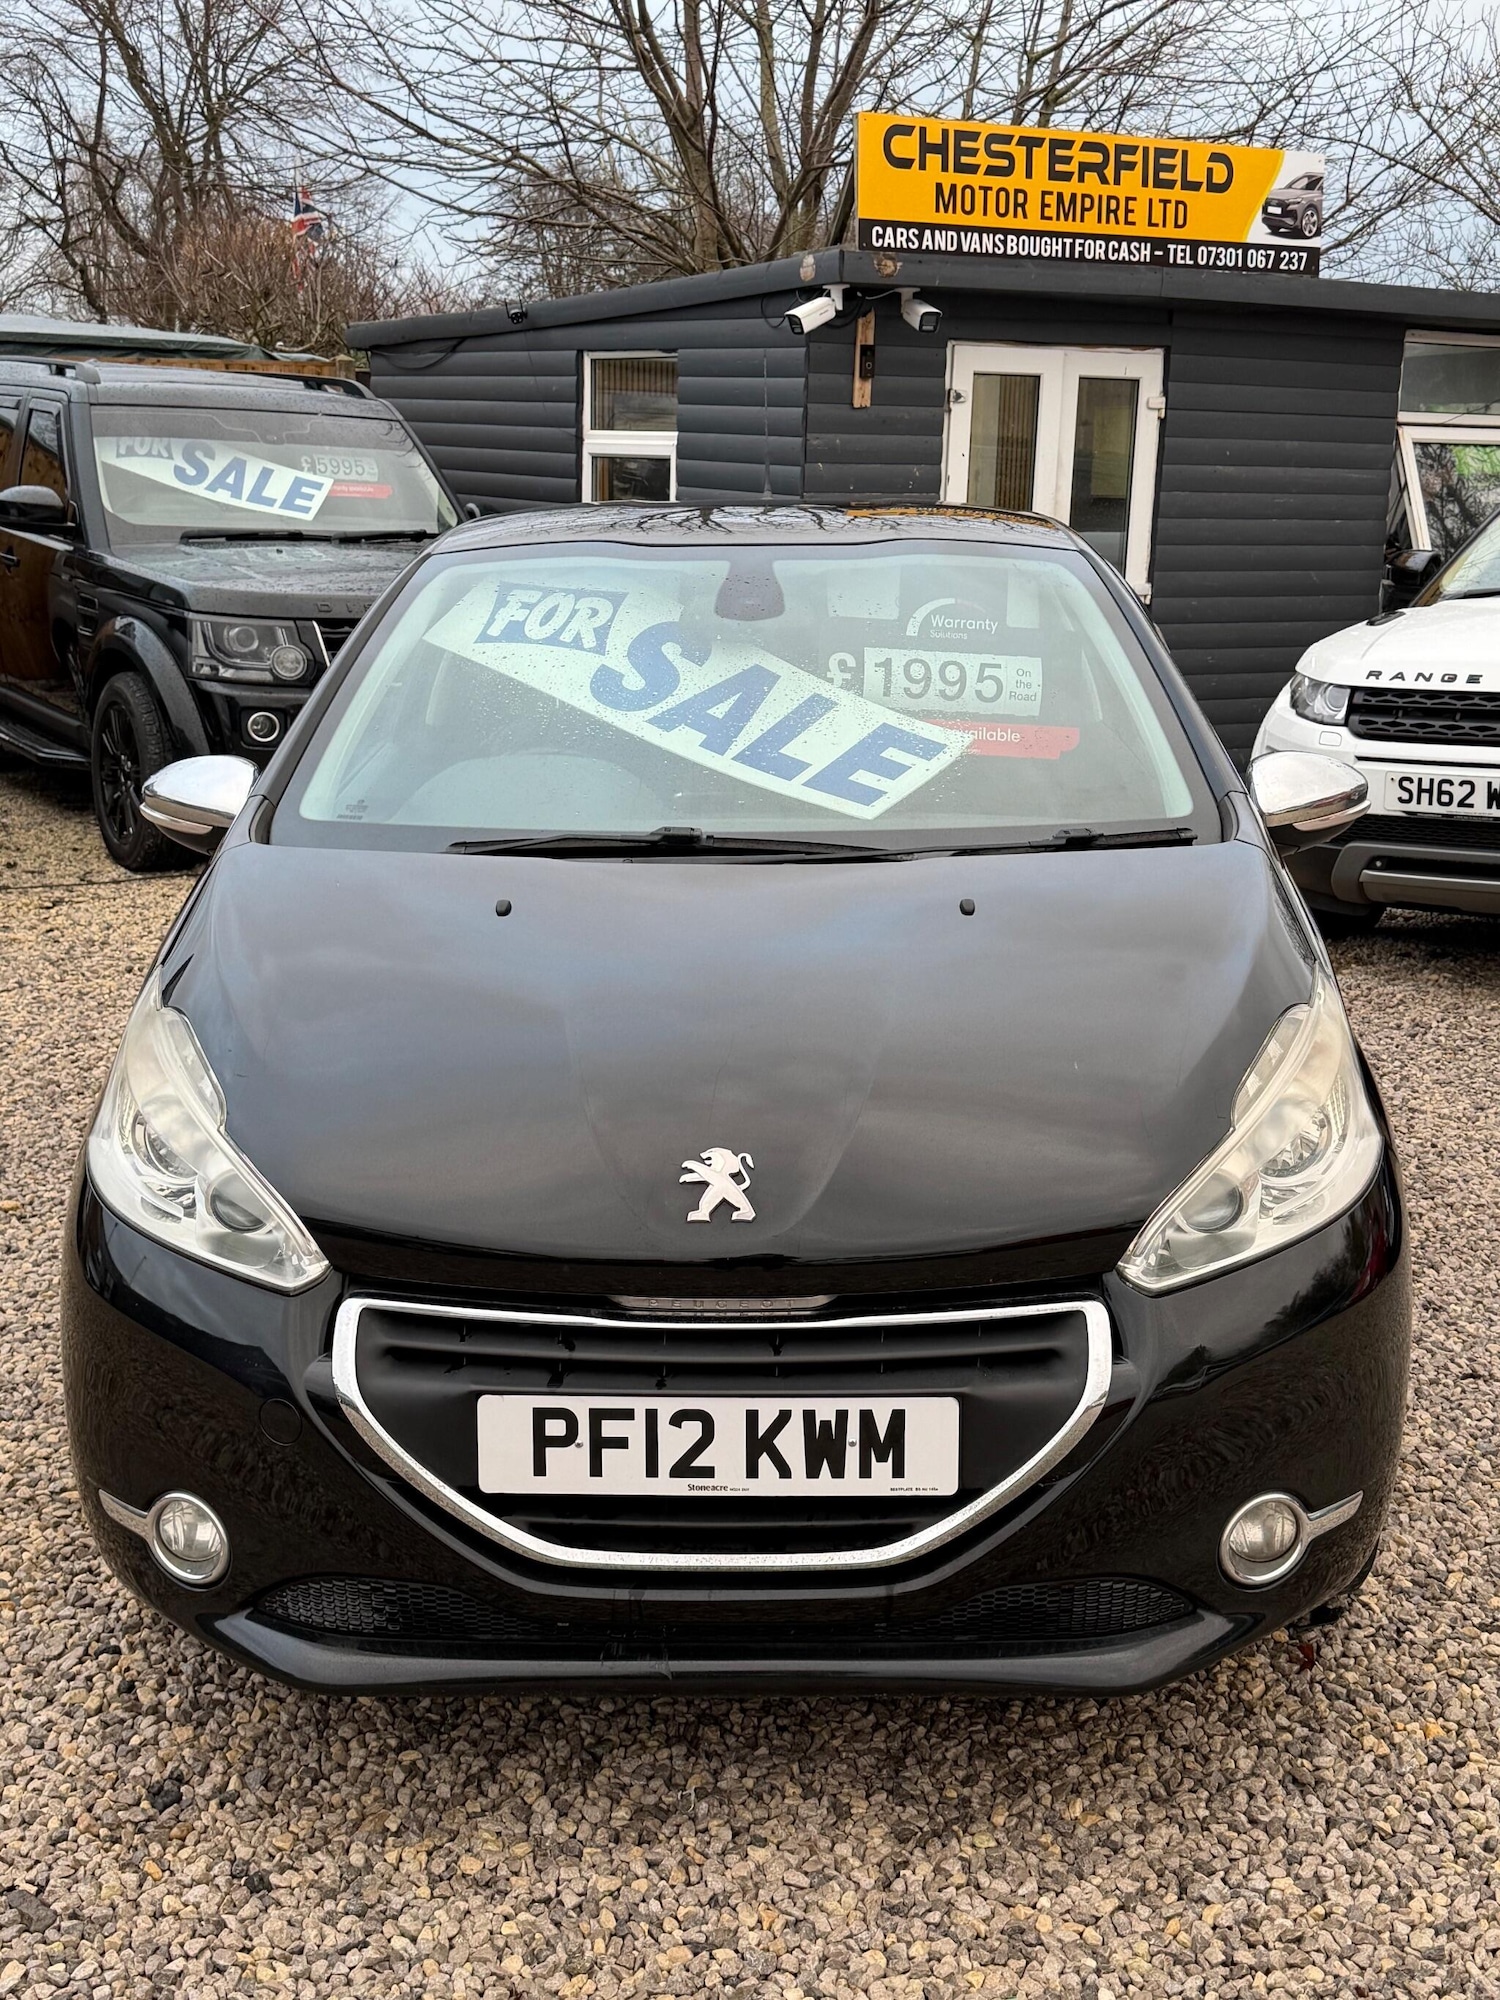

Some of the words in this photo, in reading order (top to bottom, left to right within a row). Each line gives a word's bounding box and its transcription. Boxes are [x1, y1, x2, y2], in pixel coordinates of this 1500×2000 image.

[883, 123, 1234, 194] CHESTERFIELD
[935, 182, 1028, 219] MOTOR
[1040, 190, 1137, 226] EMPIRE
[1147, 198, 1188, 229] LTD
[871, 225, 919, 250] CARS
[921, 229, 958, 252] AND
[959, 231, 1005, 255] VANS
[1009, 234, 1073, 259] BOUGHT
[1074, 239, 1106, 260] FOR
[1108, 241, 1150, 263] CASH
[1167, 244, 1194, 265] TEL
[1197, 246, 1242, 268] 07301
[1246, 248, 1275, 269] 067
[1279, 251, 1308, 271] 237
[173, 442, 325, 514] SALE
[930, 614, 998, 635] Warranty
[930, 629, 968, 640] Solutions
[1016, 668, 1032, 678] On
[1365, 670, 1483, 684] RANGE
[1015, 679, 1032, 690] the
[486, 589, 613, 649] FOR
[590, 620, 949, 807] SALE
[1009, 691, 1037, 702] Road
[962, 727, 1021, 742] ailable
[1397, 776, 1475, 808] SH62
[649, 1299, 794, 1310] PEUGEOT
[532, 1406, 716, 1478] PF12
[745, 1408, 906, 1479] KWM
[687, 1483, 729, 1492] Stoneacre
